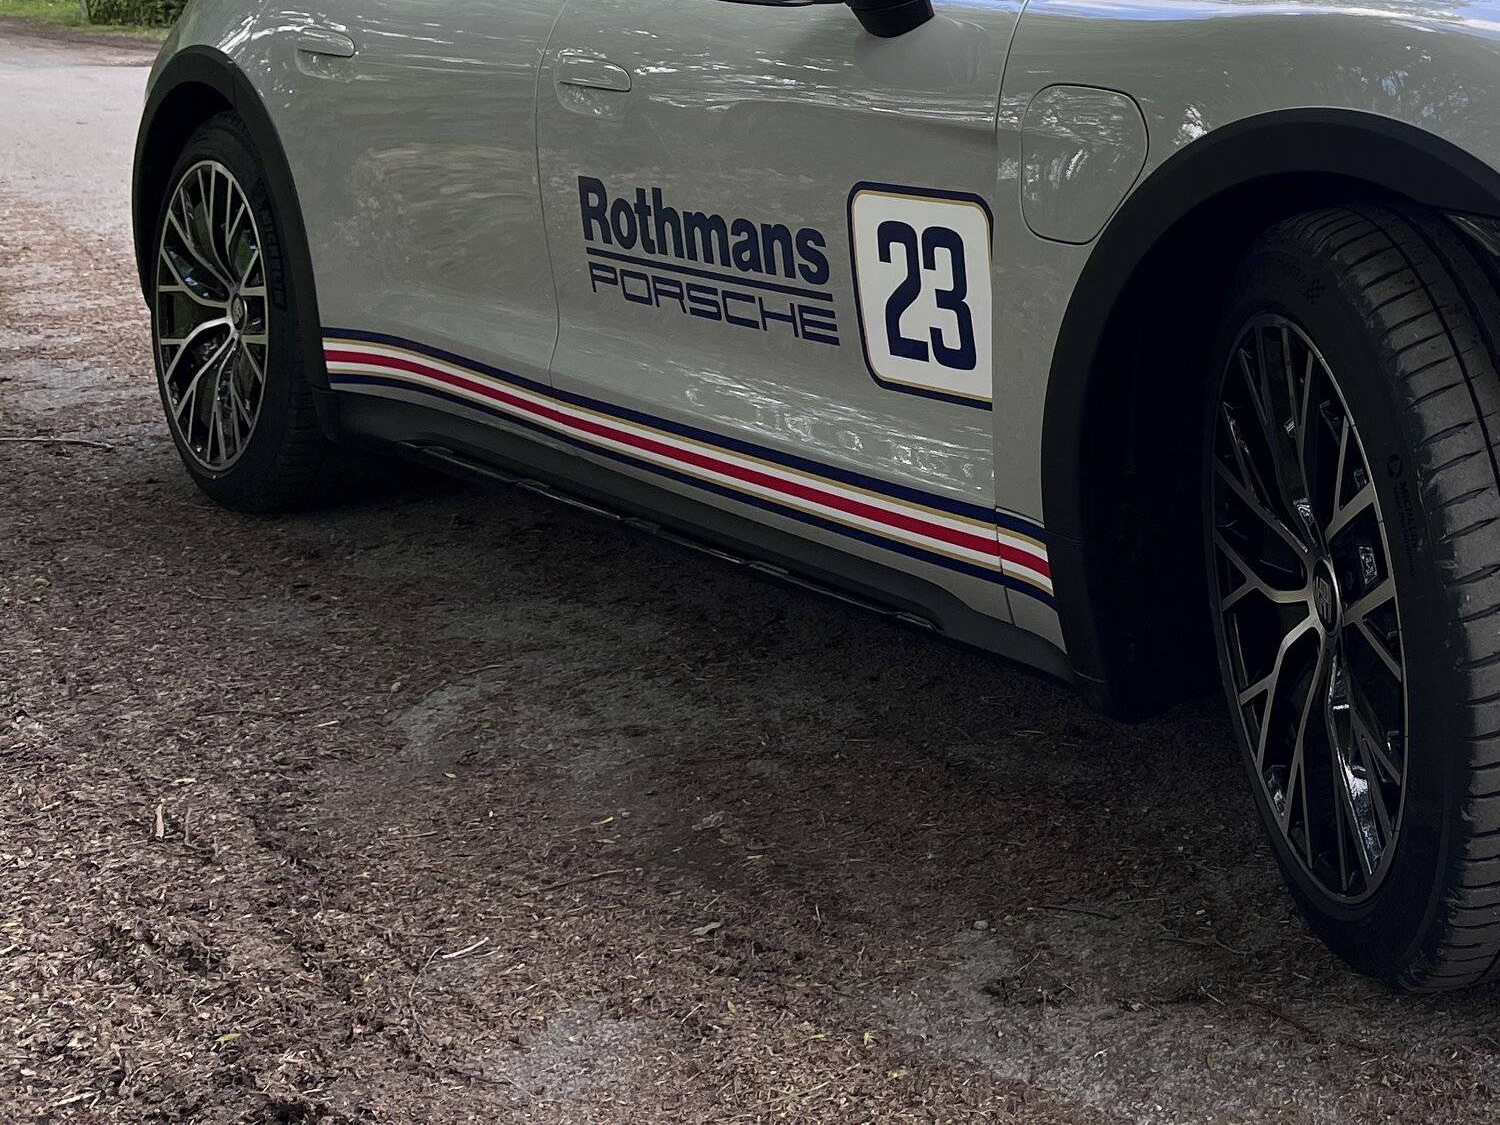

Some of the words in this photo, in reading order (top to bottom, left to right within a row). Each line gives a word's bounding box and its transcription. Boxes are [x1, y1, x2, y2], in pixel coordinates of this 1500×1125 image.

[578, 175, 831, 285] Rothmans
[588, 261, 840, 346] PORSCHE
[877, 220, 977, 371] 23
